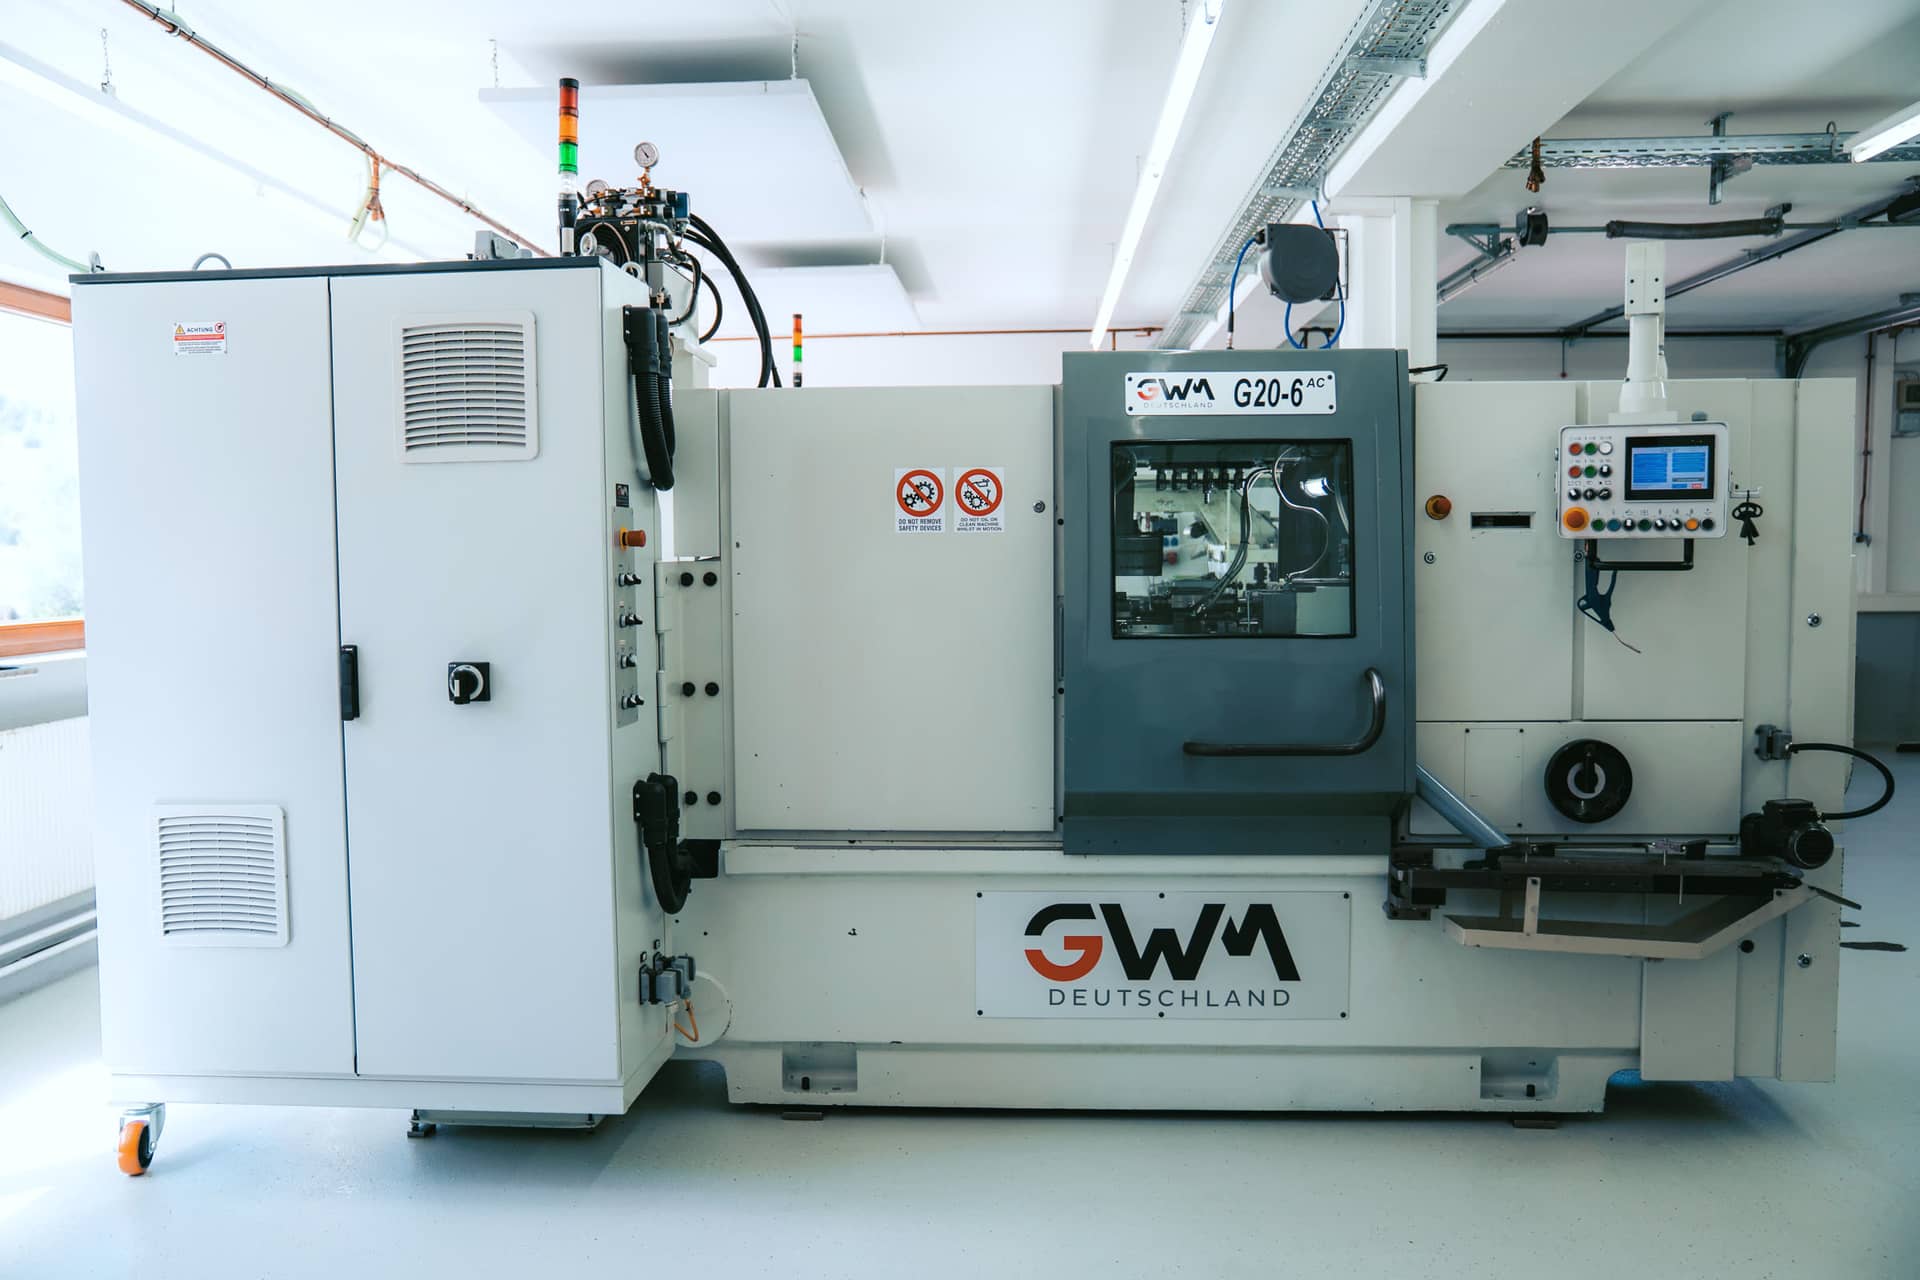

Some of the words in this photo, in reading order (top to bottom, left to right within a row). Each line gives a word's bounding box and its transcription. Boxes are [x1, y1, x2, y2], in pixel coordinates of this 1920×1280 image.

[1136, 378, 1215, 401] GWM
[1233, 378, 1304, 408] G20-6
[1306, 377, 1326, 388] AC
[1024, 903, 1301, 981] GWM
[1048, 988, 1291, 1007] DEUTSCHLAND
